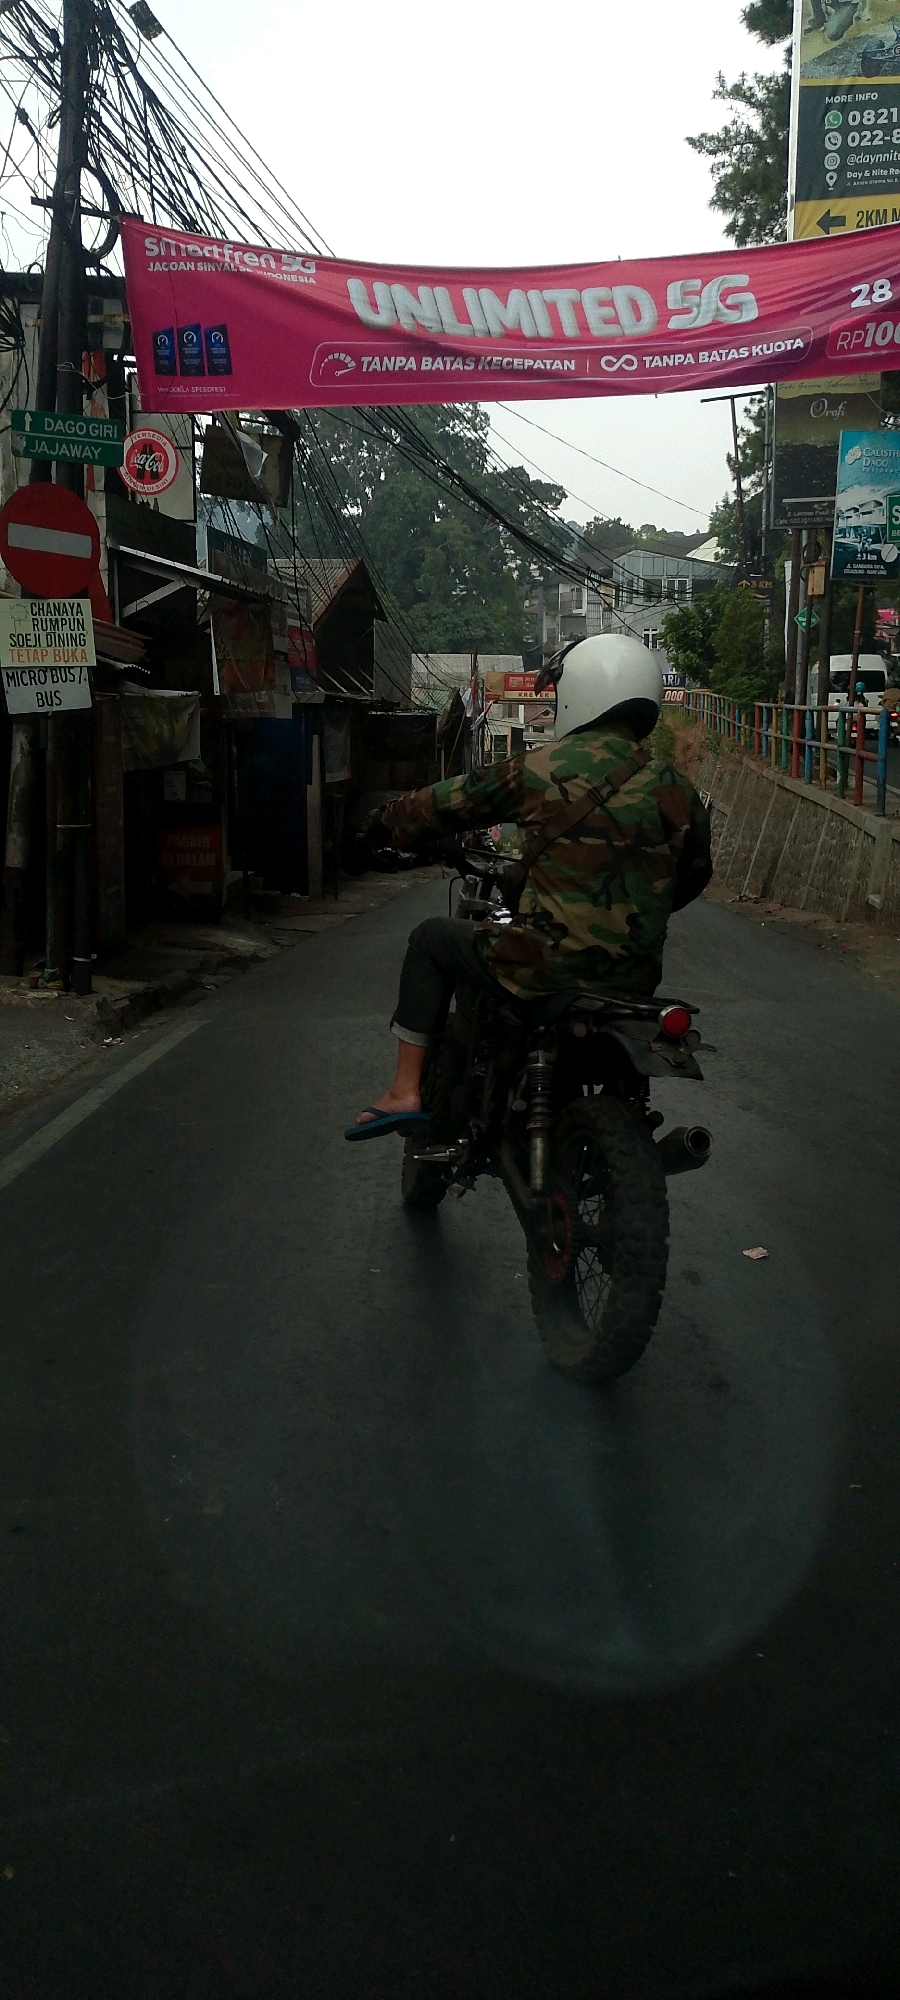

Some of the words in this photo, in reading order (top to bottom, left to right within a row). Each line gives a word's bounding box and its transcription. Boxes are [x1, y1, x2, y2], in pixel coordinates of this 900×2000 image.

[825, 95, 853, 104] MORE
[855, 92, 878, 102] INFO
[848, 107, 898, 126] 0821
[847, 171, 862, 180] Day
[864, 169, 871, 177] &
[872, 168, 888, 176] Nite
[856, 209, 887, 228] 2KM
[144, 237, 276, 270] smartfren
[281, 253, 316, 274] 5G
[197, 261, 237, 272] SINYAL
[850, 278, 893, 308] 28
[346, 278, 659, 338] UNLIMITED
[666, 274, 759, 330] 5G
[642, 353, 695, 369] TANPA
[698, 346, 750, 364] BATAS
[752, 338, 804, 357] KUOTA
[361, 356, 417, 372] TANPA
[420, 356, 476, 371] BATAS
[477, 356, 575, 371] KECEPATAN
[44, 417, 87, 435] DAGO
[89, 421, 118, 439] GIRI
[133, 432, 167, 447] TERSEDIA
[29, 439, 102, 460] JAJAWAY
[863, 457, 889, 467] DAGO
[30, 602, 84, 617] CHANAYA
[32, 617, 85, 633] RUMPUN
[9, 632, 42, 648] SOEJI
[45, 632, 87, 648] DINING
[9, 649, 49, 663] TETAP
[53, 649, 88, 664] BUKA
[6, 667, 48, 688] MICRO
[36, 688, 63, 708] BUS
